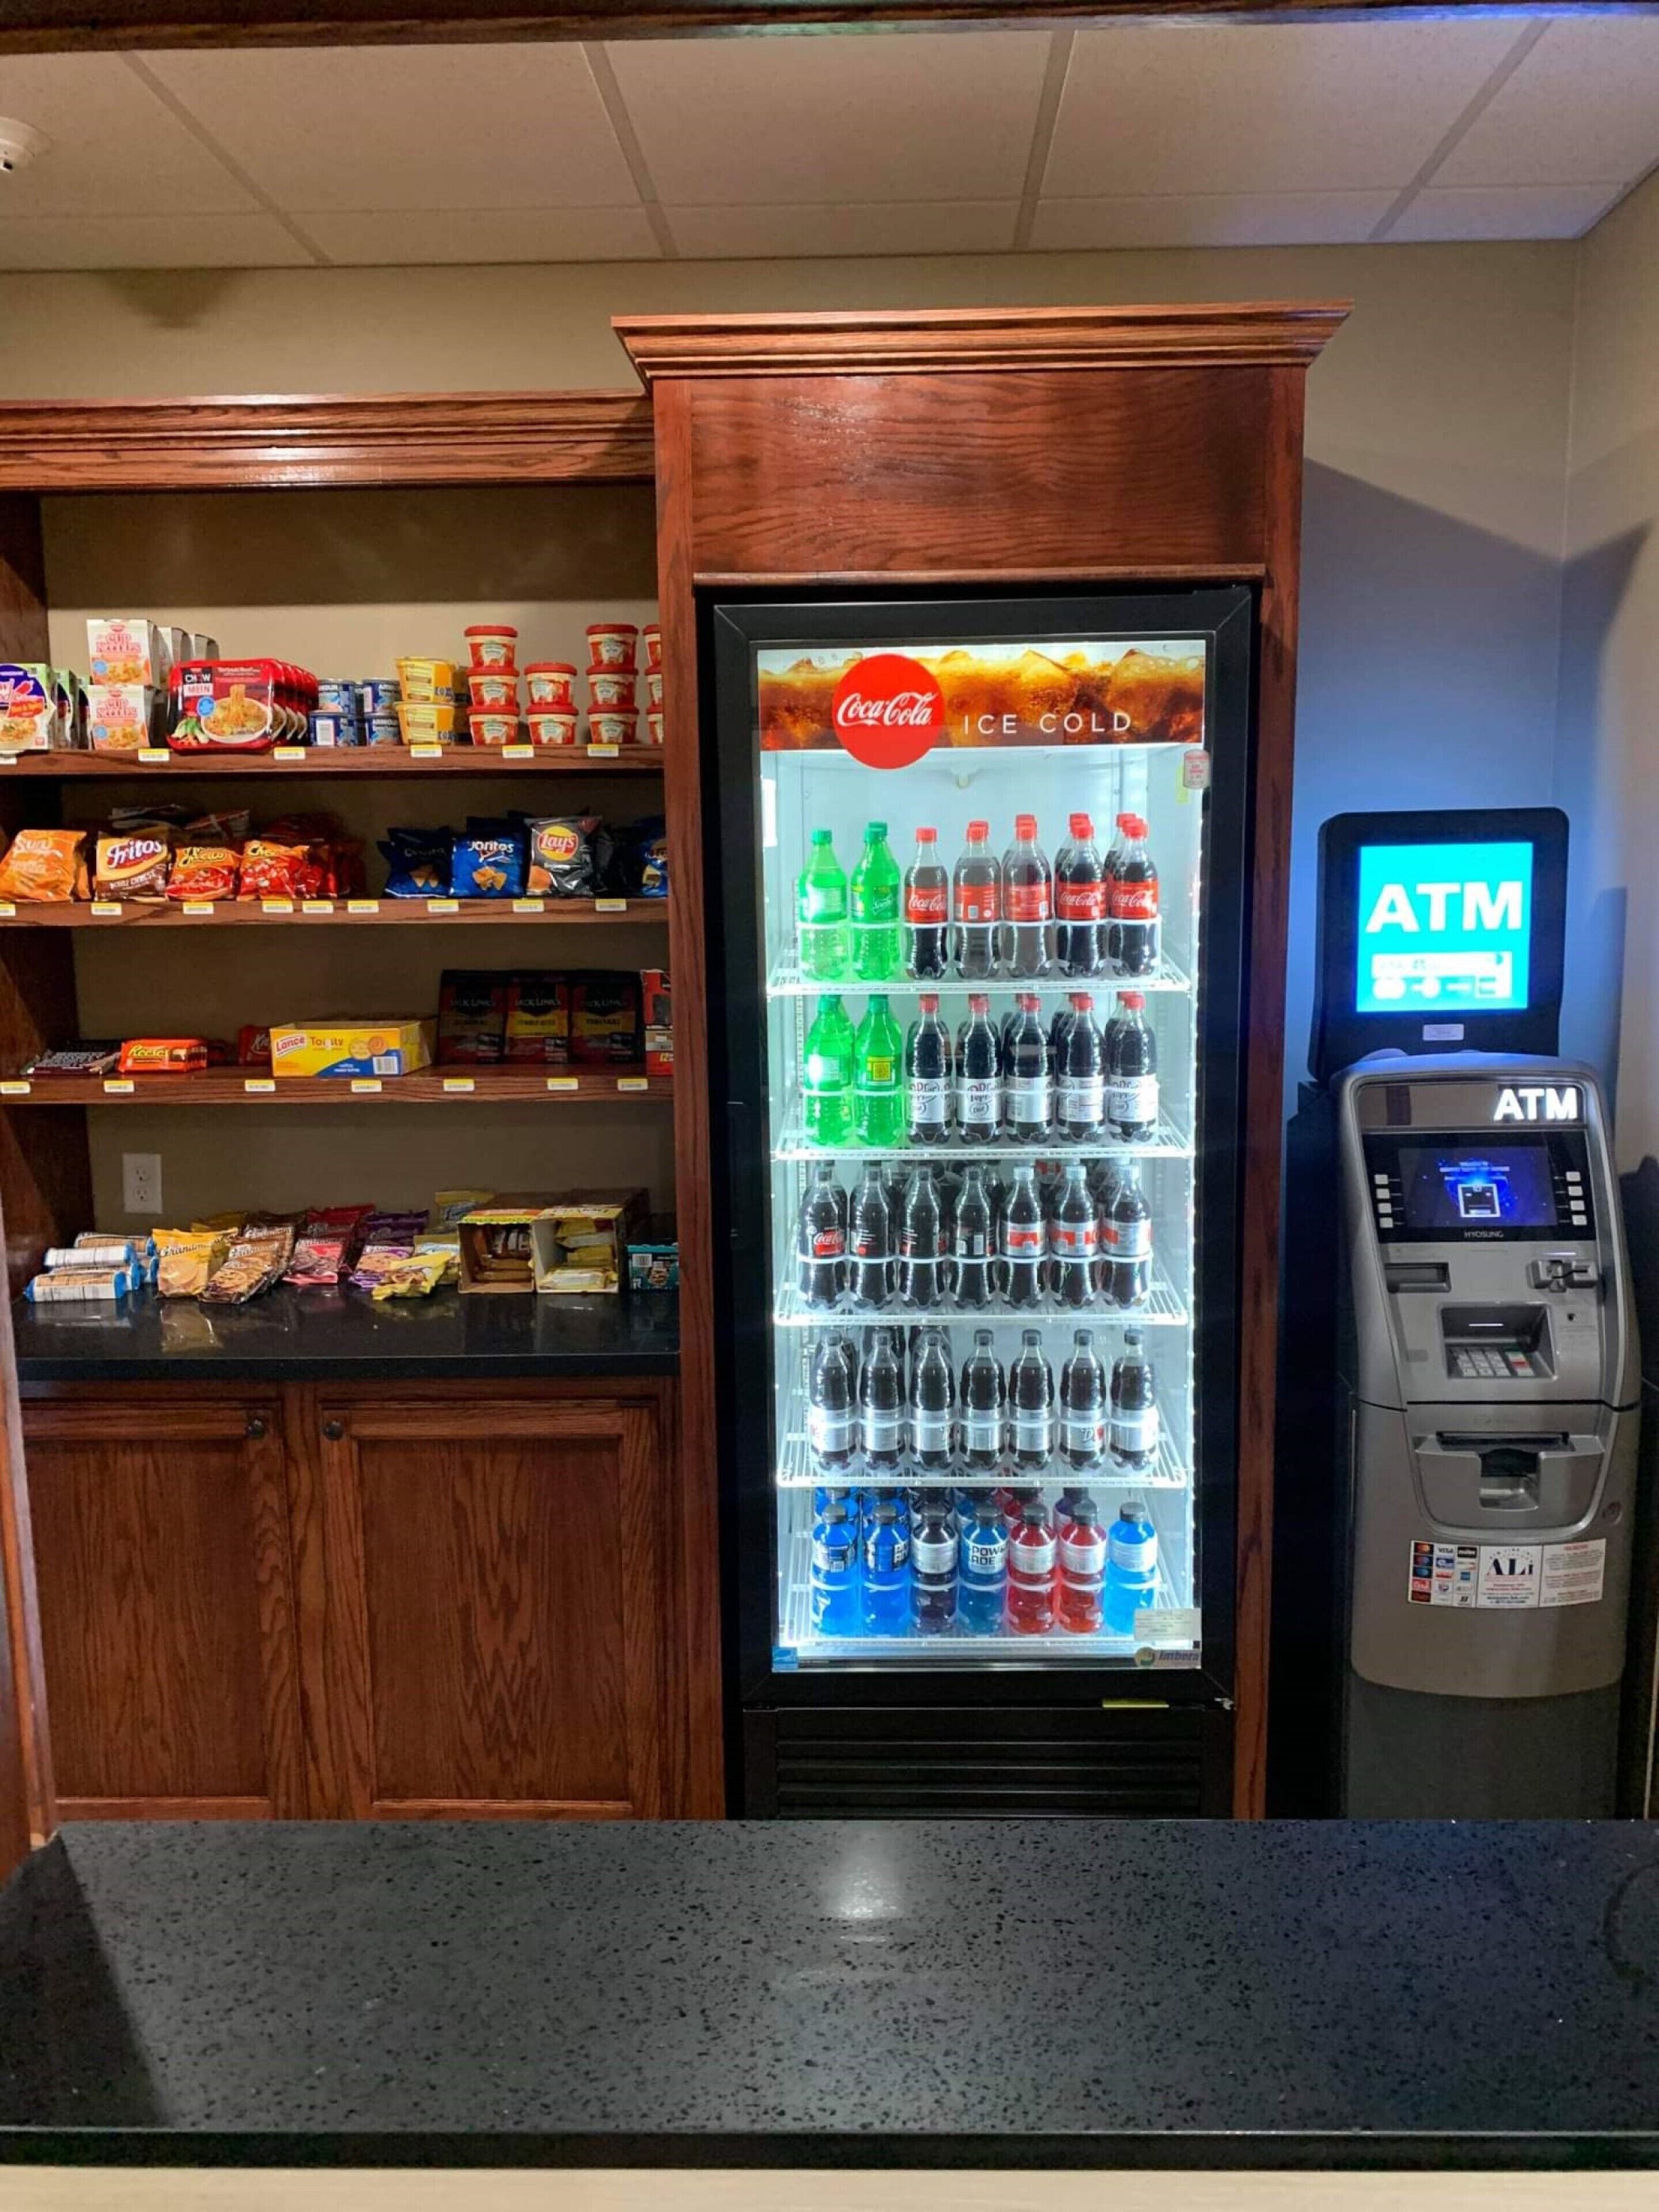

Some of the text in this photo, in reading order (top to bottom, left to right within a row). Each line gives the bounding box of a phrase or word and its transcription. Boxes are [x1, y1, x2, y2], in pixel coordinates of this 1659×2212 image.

[836, 692, 938, 727] Coca-Cola
[964, 711, 1131, 734] ICE COLD
[107, 839, 162, 868] Fritos
[1365, 881, 1523, 933] ATM
[276, 1036, 305, 1052] Lance
[1494, 1088, 1577, 1121] ATM
[1464, 1230, 1503, 1238] HYOSUNG
